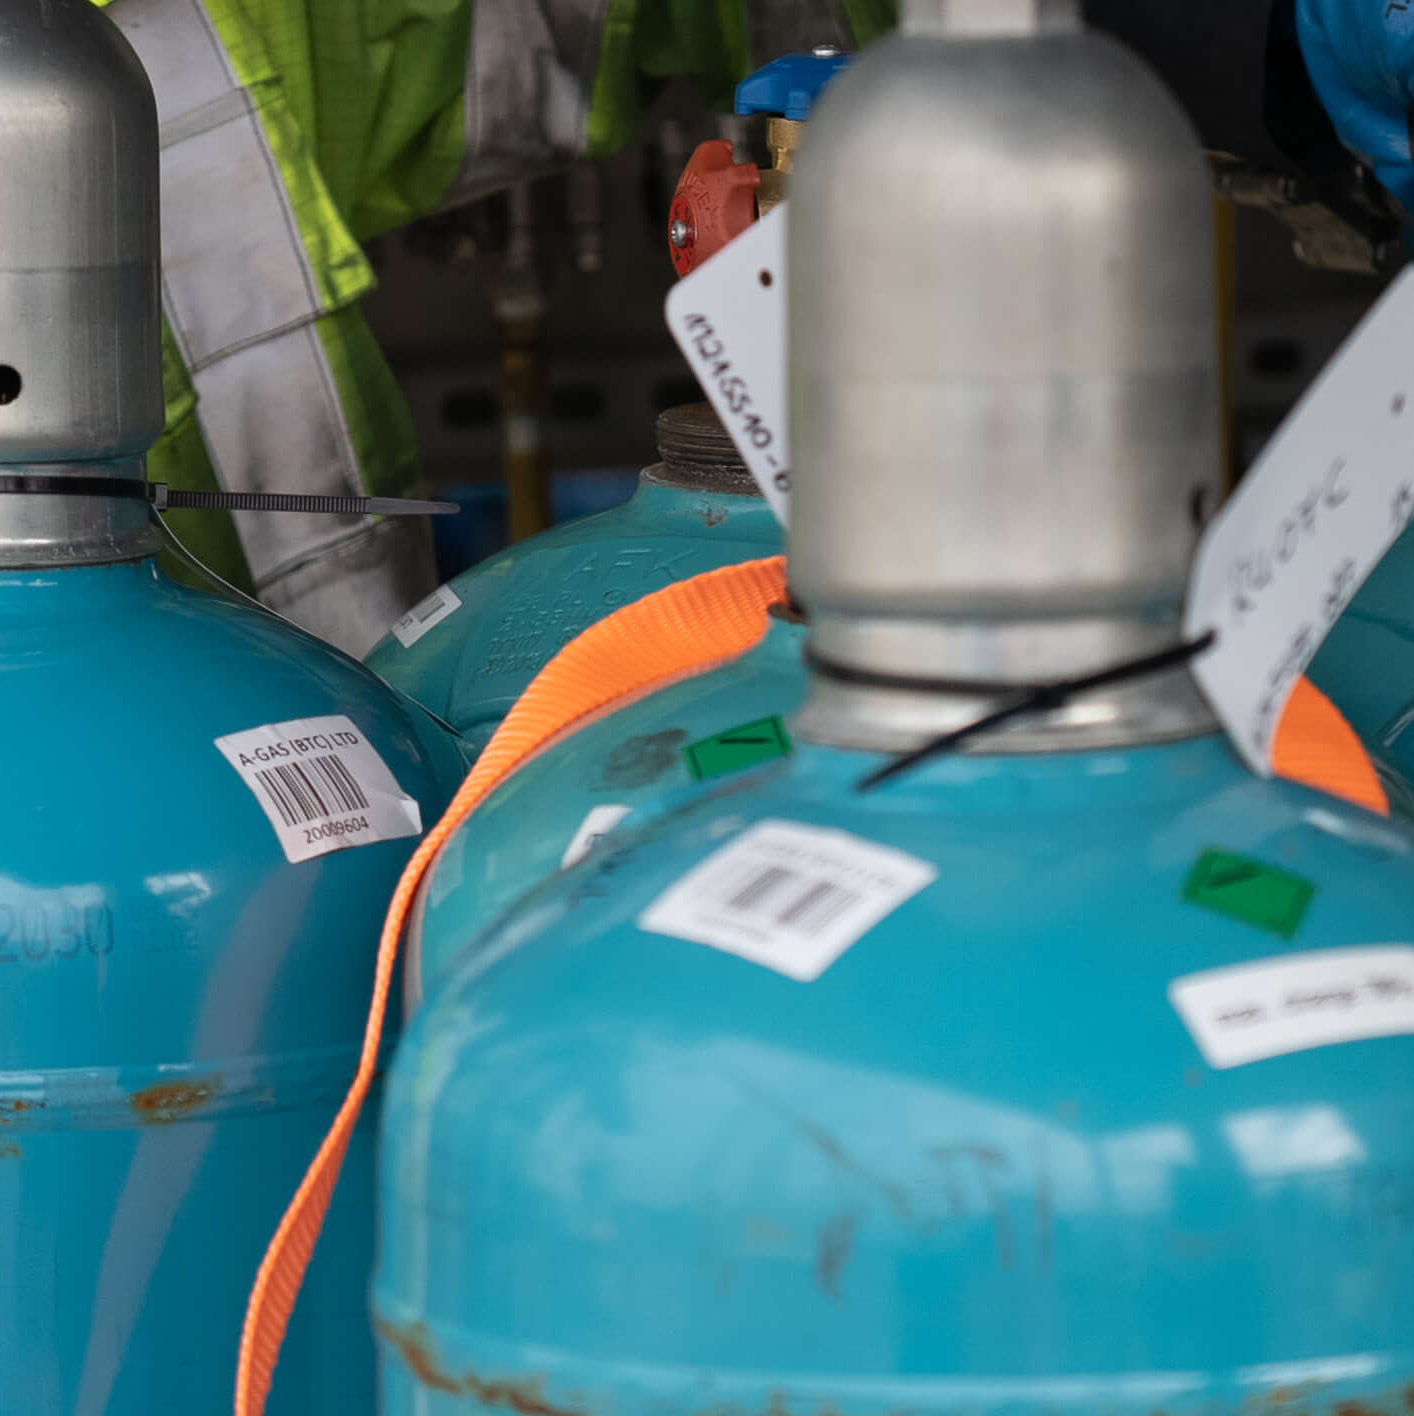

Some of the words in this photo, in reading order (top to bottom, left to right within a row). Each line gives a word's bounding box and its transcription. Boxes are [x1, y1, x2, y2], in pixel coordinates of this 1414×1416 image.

[238, 741, 291, 768] A-GAS
[289, 733, 333, 757] (BTC)
[329, 731, 360, 748] LTD
[302, 815, 371, 845] 20009604
